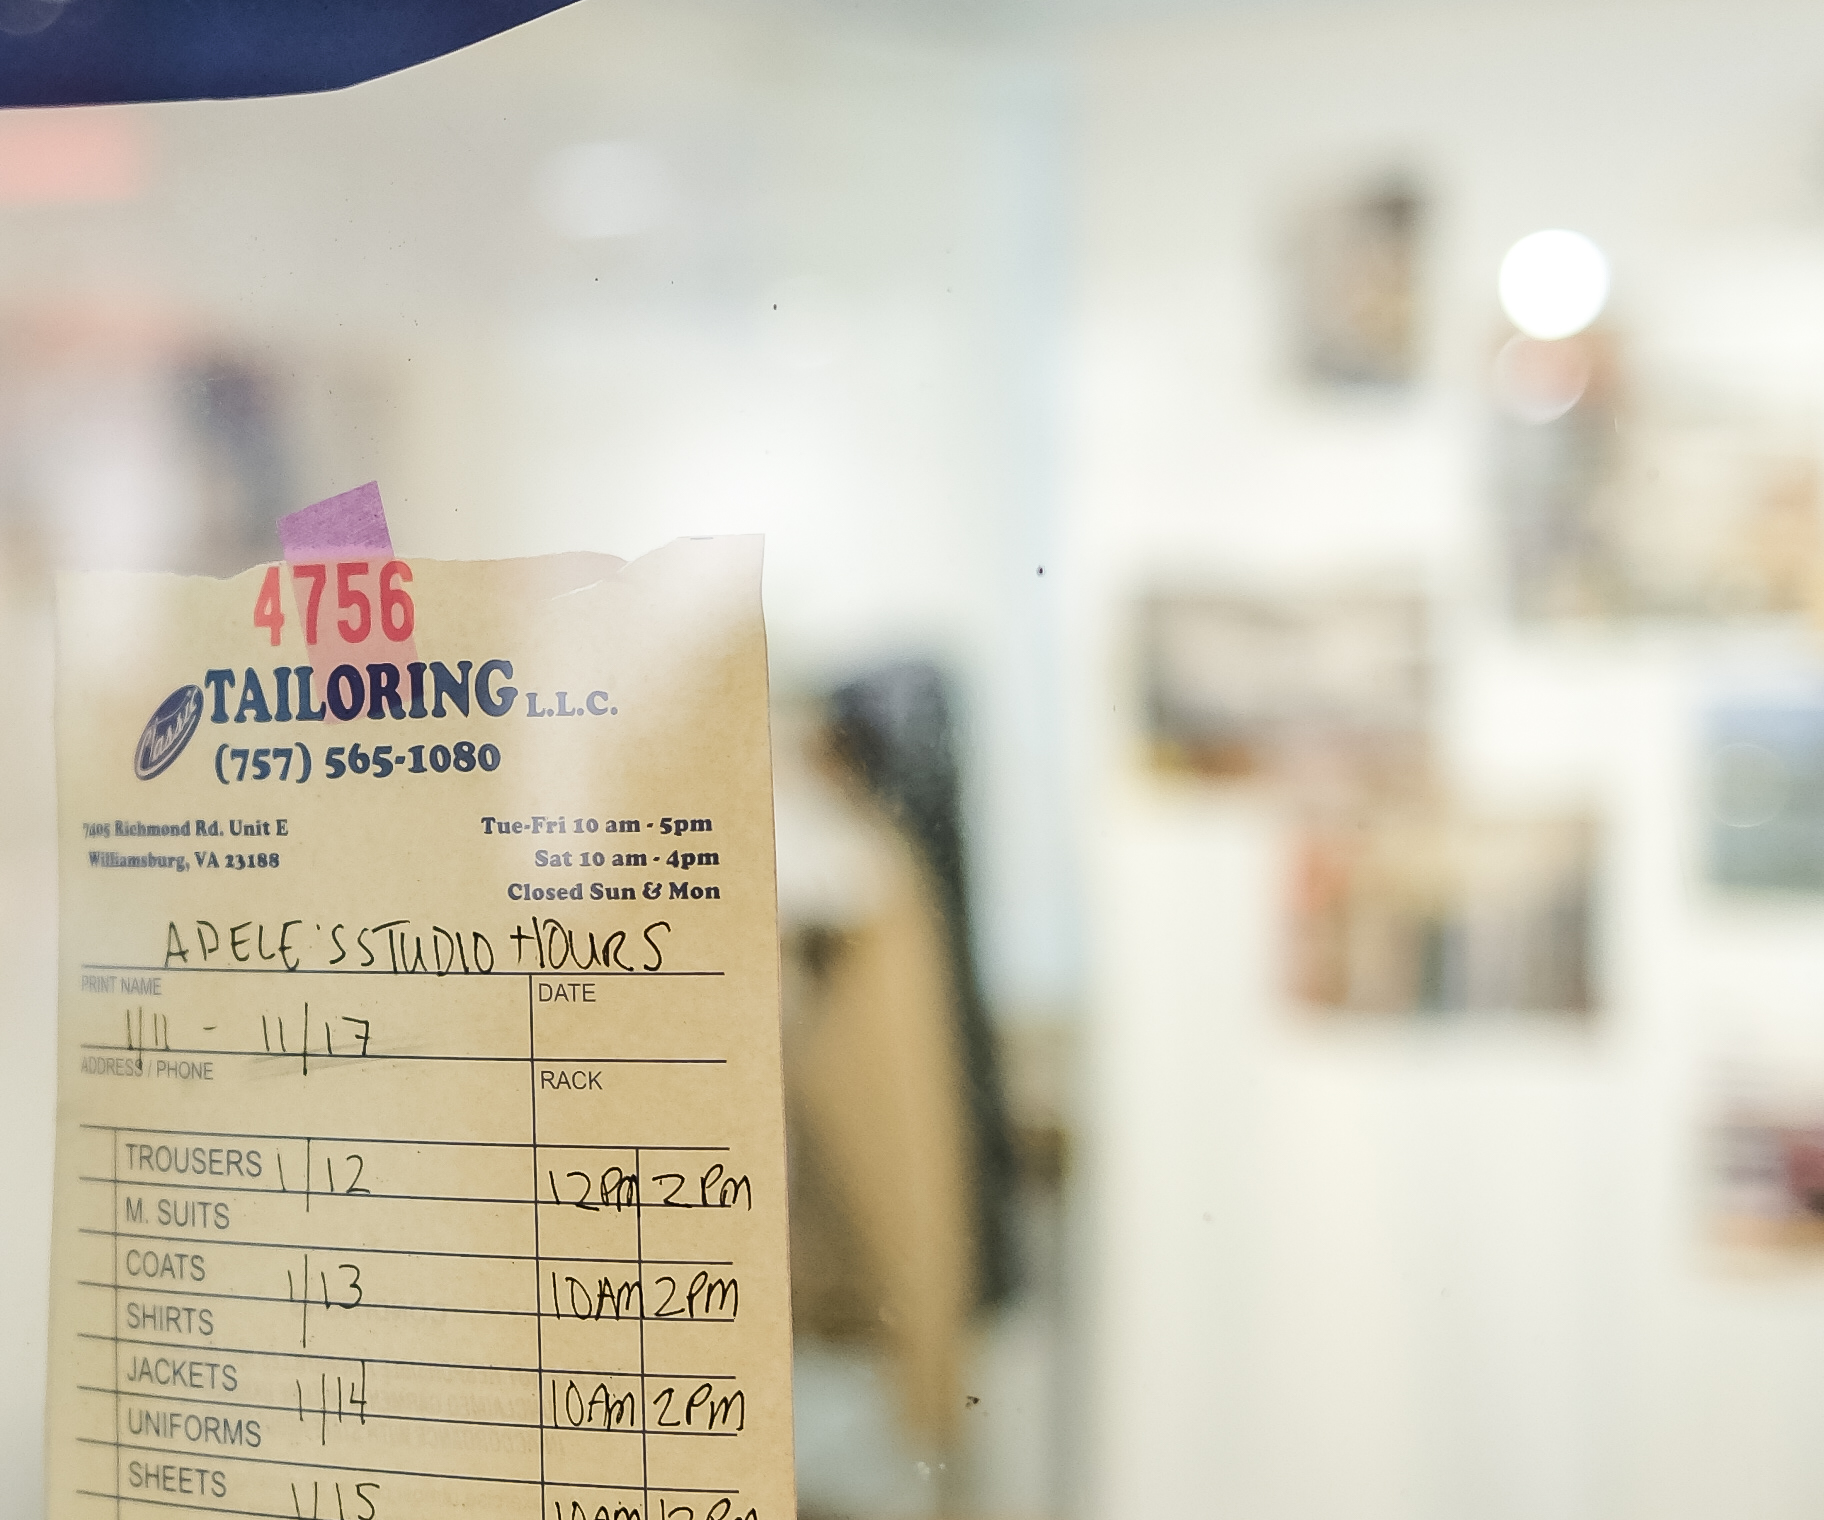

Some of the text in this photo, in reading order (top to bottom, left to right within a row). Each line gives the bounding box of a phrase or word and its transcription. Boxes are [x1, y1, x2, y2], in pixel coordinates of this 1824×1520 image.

[253, 559, 416, 647] 4756
[204, 659, 518, 724] TAILORING
[525, 691, 619, 719] L.L.C.
[214, 741, 501, 785] (757) 565-1080
[114, 819, 191, 837] Richmond
[195, 819, 224, 837] Rd.
[229, 818, 272, 837] Unit
[276, 818, 289, 836] E
[481, 817, 566, 836] Tue-Fri
[573, 818, 599, 835] 10
[604, 820, 642, 834] am
[659, 815, 714, 838] 5pm
[194, 851, 220, 869] VA
[225, 851, 280, 871] 23188
[534, 850, 574, 868] Sat
[579, 852, 607, 868] 10
[612, 854, 648, 868] am
[665, 849, 721, 871] 4pm
[507, 882, 721, 902] Closed Sun & Mon
[509, 916, 673, 972] HOURS
[120, 977, 163, 997] NAME
[538, 982, 597, 1004] DATE
[156, 1060, 214, 1082] PHONE
[539, 1070, 603, 1091] RACK
[125, 1142, 263, 1179] TROUSERS
[125, 1196, 231, 1231] M. SUITS
[125, 1249, 207, 1283] COATS
[125, 1302, 216, 1338] SHIRTS
[127, 1354, 239, 1394] JACKETS
[127, 1409, 263, 1449] UNIFORMS
[127, 1461, 228, 1499] SHEETS
